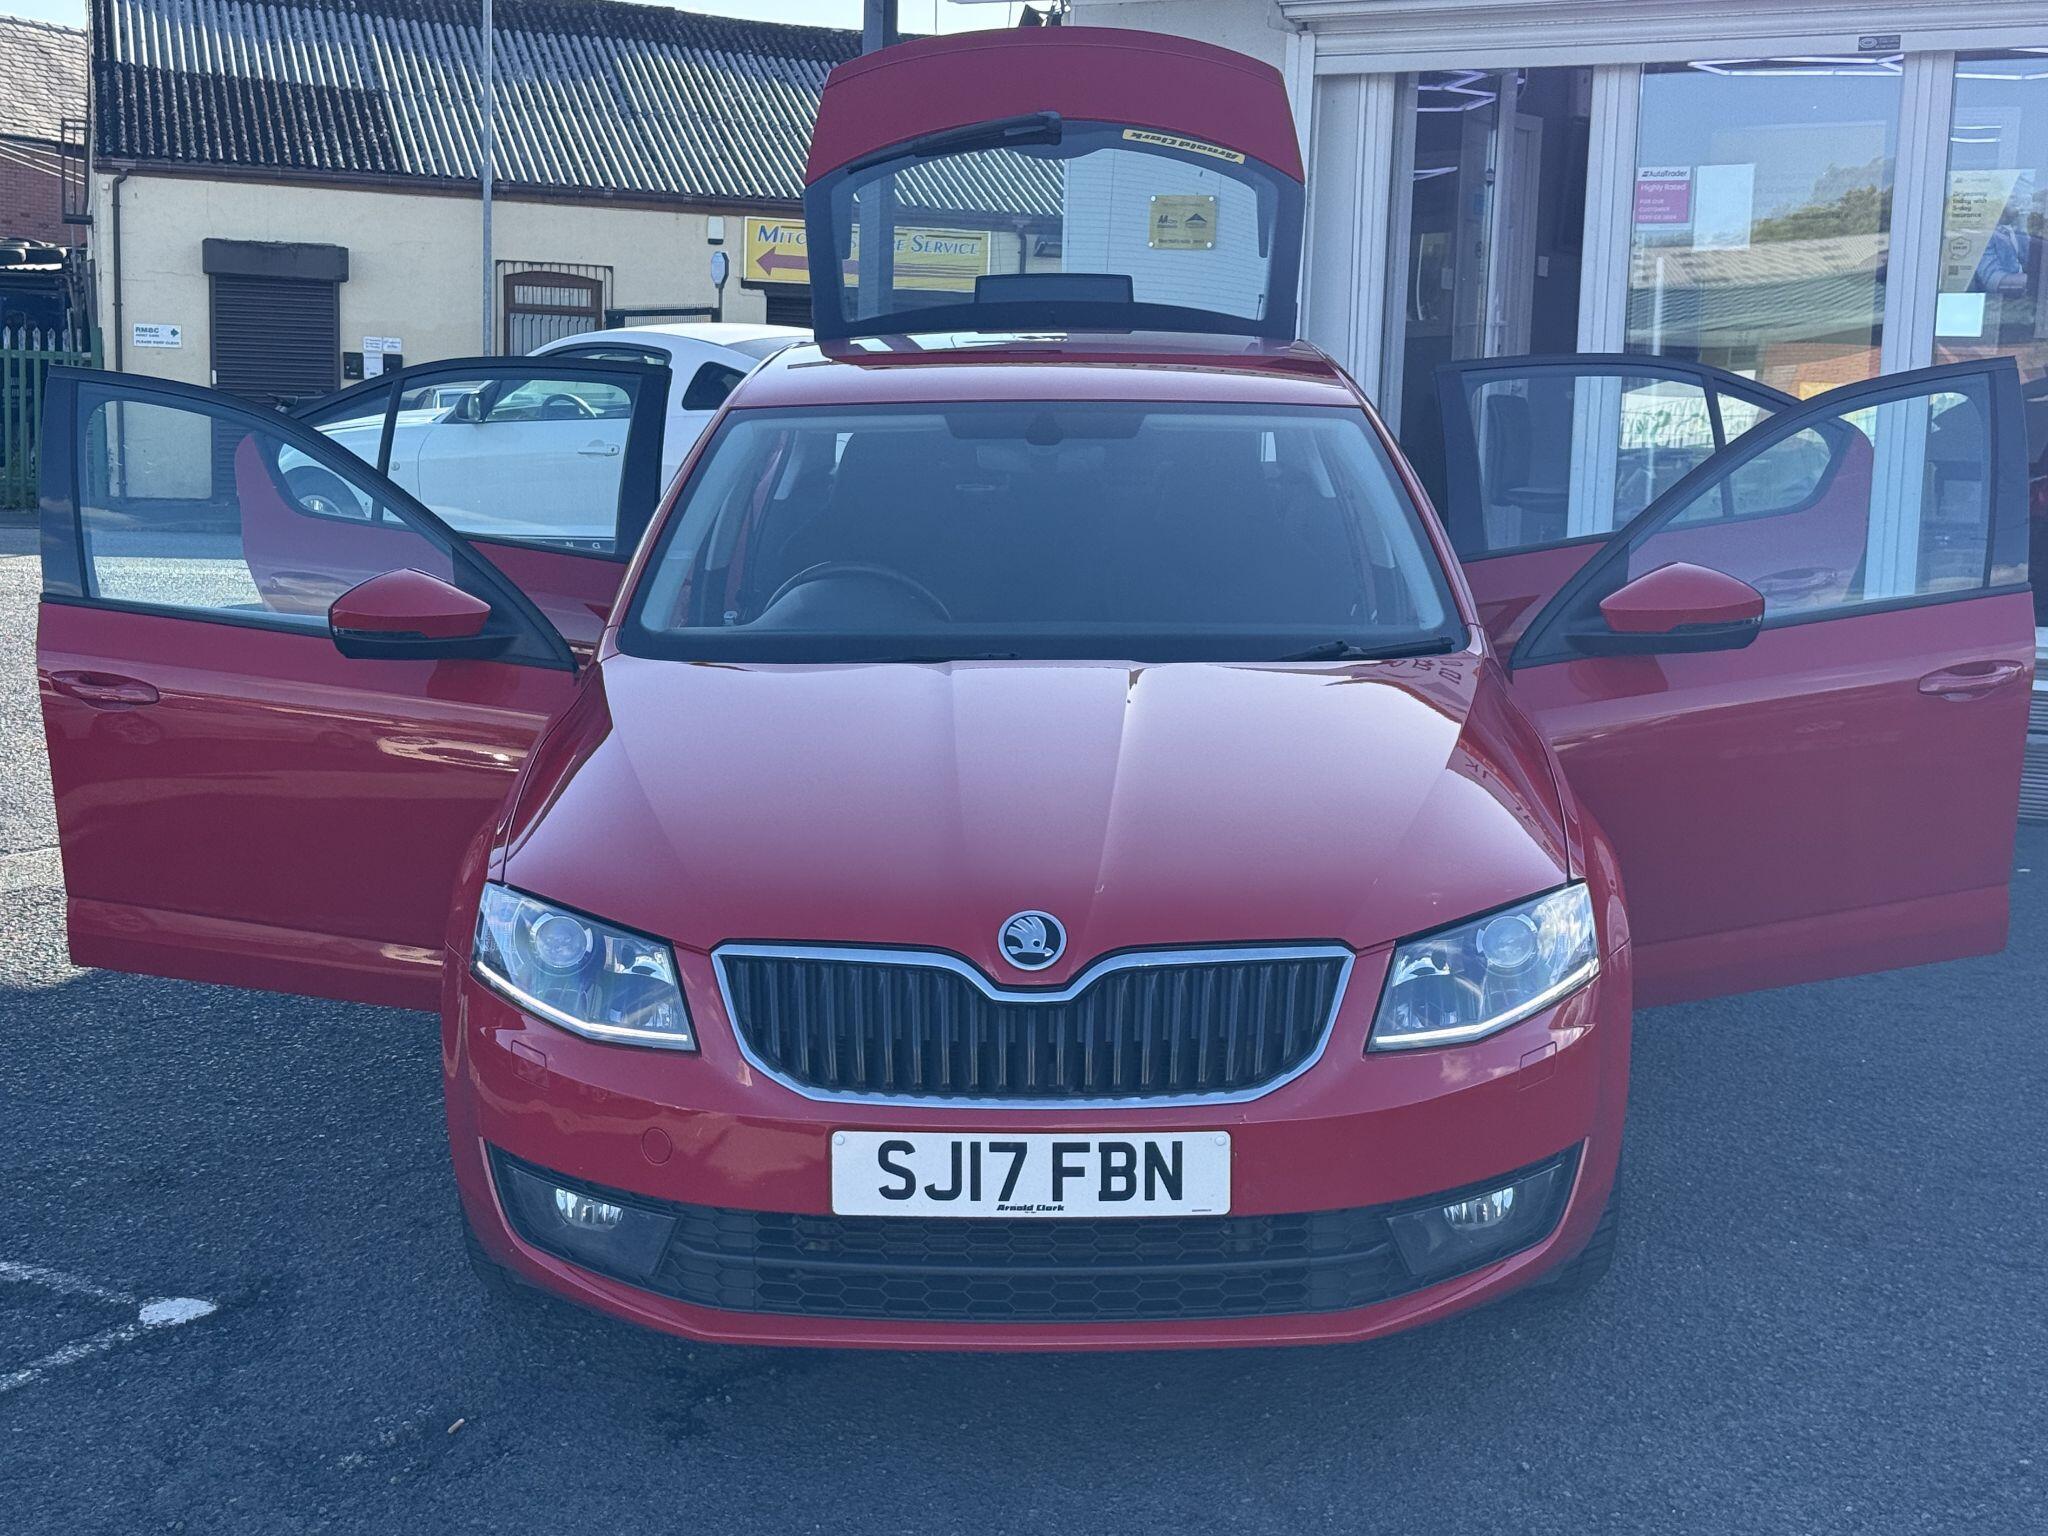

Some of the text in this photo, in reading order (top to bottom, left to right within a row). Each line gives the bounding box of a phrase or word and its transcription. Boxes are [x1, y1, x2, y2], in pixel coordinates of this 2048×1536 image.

[1131, 132, 1239, 160] Arnold Clark
[1640, 184, 1663, 192] Highly
[911, 234, 978, 254] SERVICE
[877, 1140, 1183, 1201] SJ17 FBN
